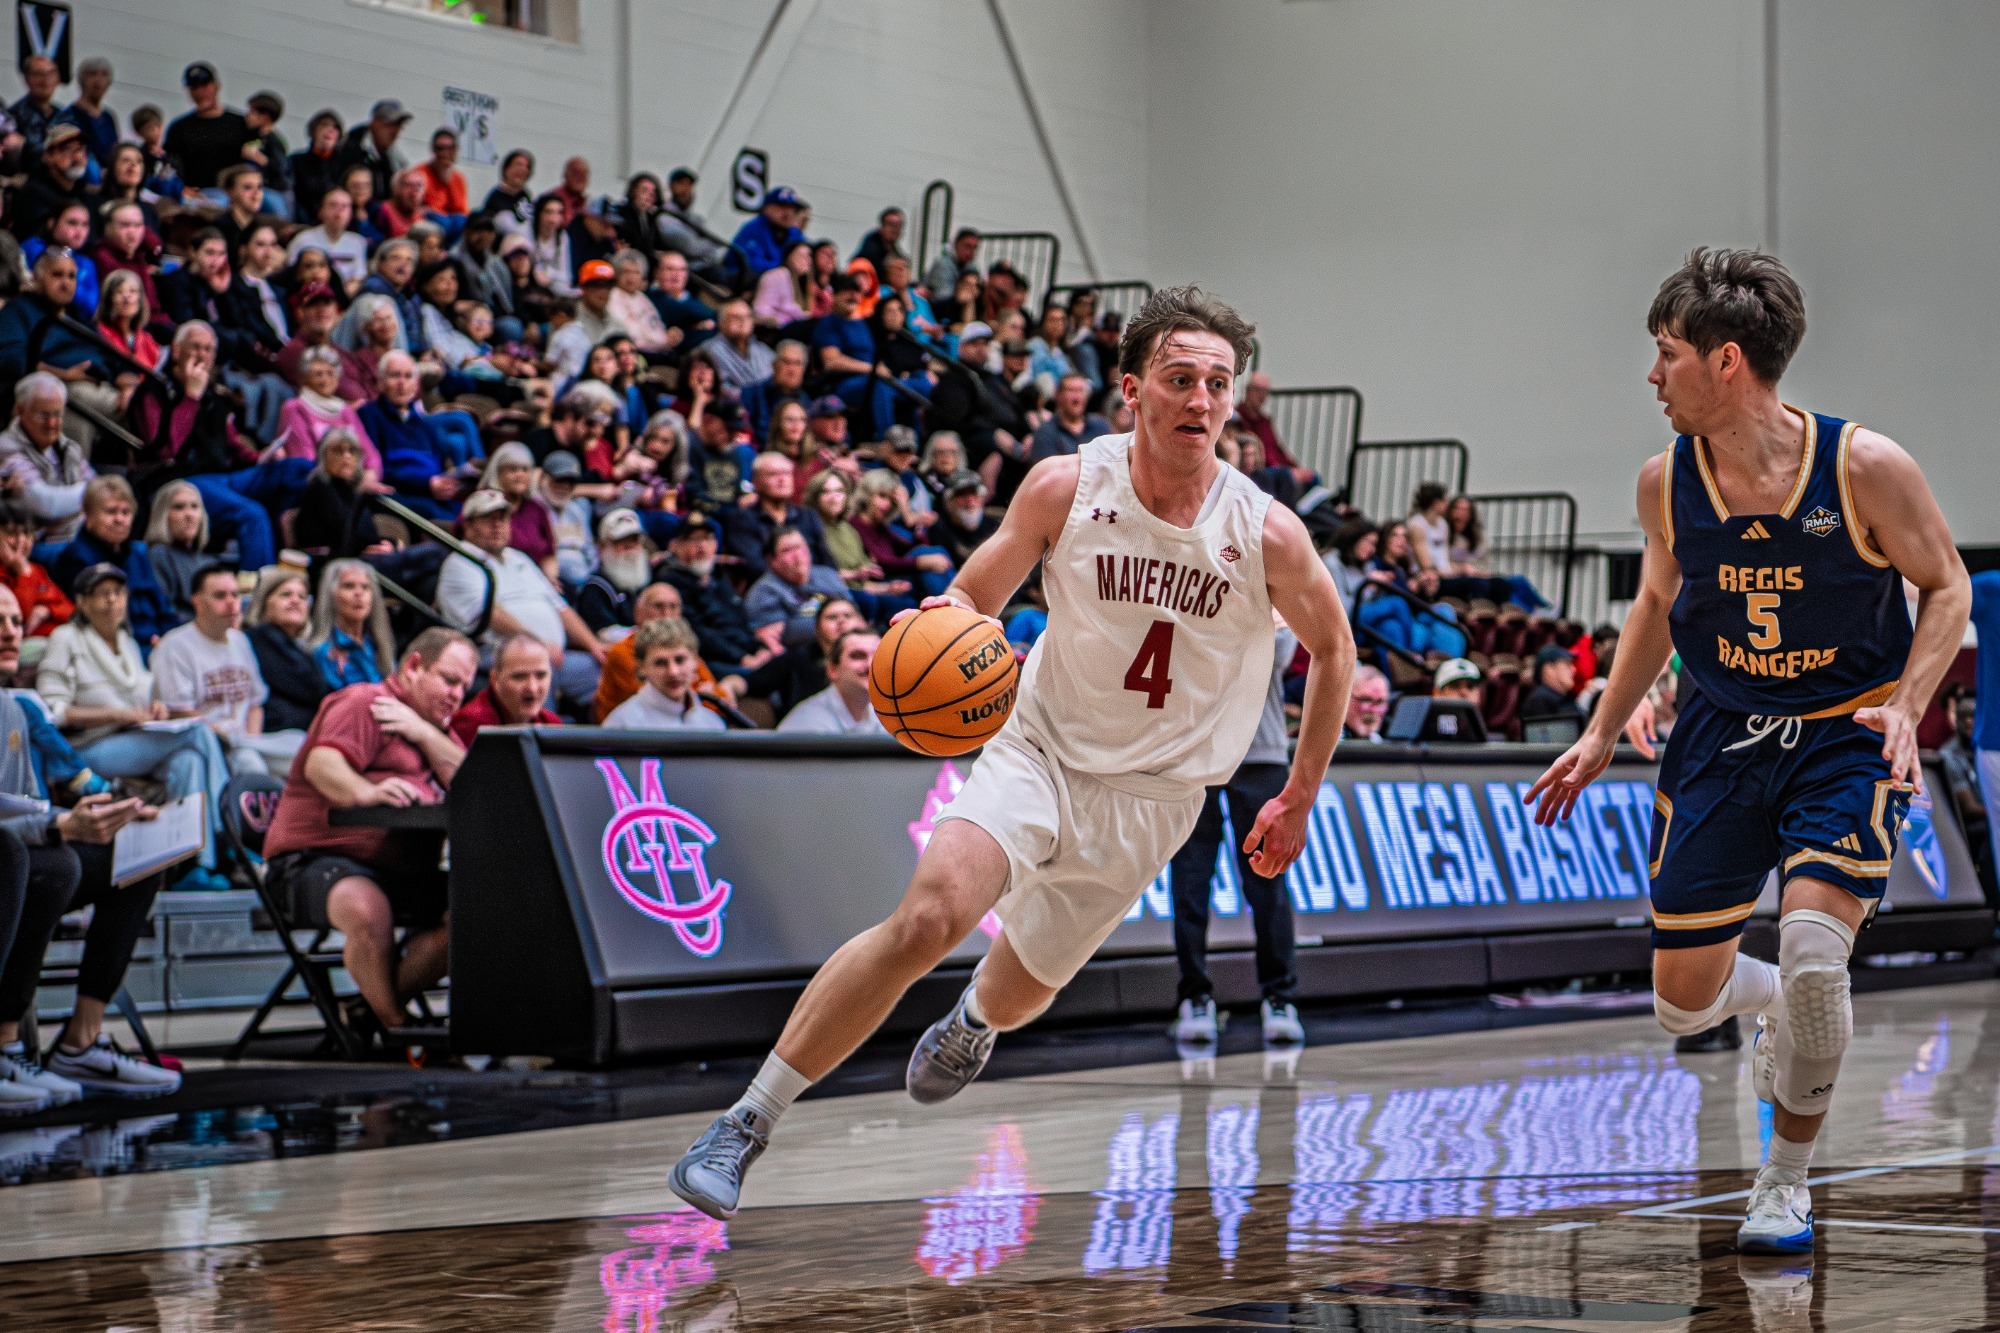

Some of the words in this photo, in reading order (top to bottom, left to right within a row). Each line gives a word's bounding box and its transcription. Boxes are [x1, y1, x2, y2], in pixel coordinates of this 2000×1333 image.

[22, 4, 68, 58] V
[737, 154, 764, 209] S
[1805, 515, 1839, 530] RMAC
[1220, 549, 1240, 559] RMAC
[1718, 564, 1804, 592] REGIS
[1096, 554, 1230, 619] MAVERICKS
[1746, 593, 1782, 650] 5
[958, 636, 1007, 681] NCAA
[1123, 620, 1175, 709] 4
[1717, 635, 1839, 679] RANGERS
[1353, 781, 1508, 909] MESA
